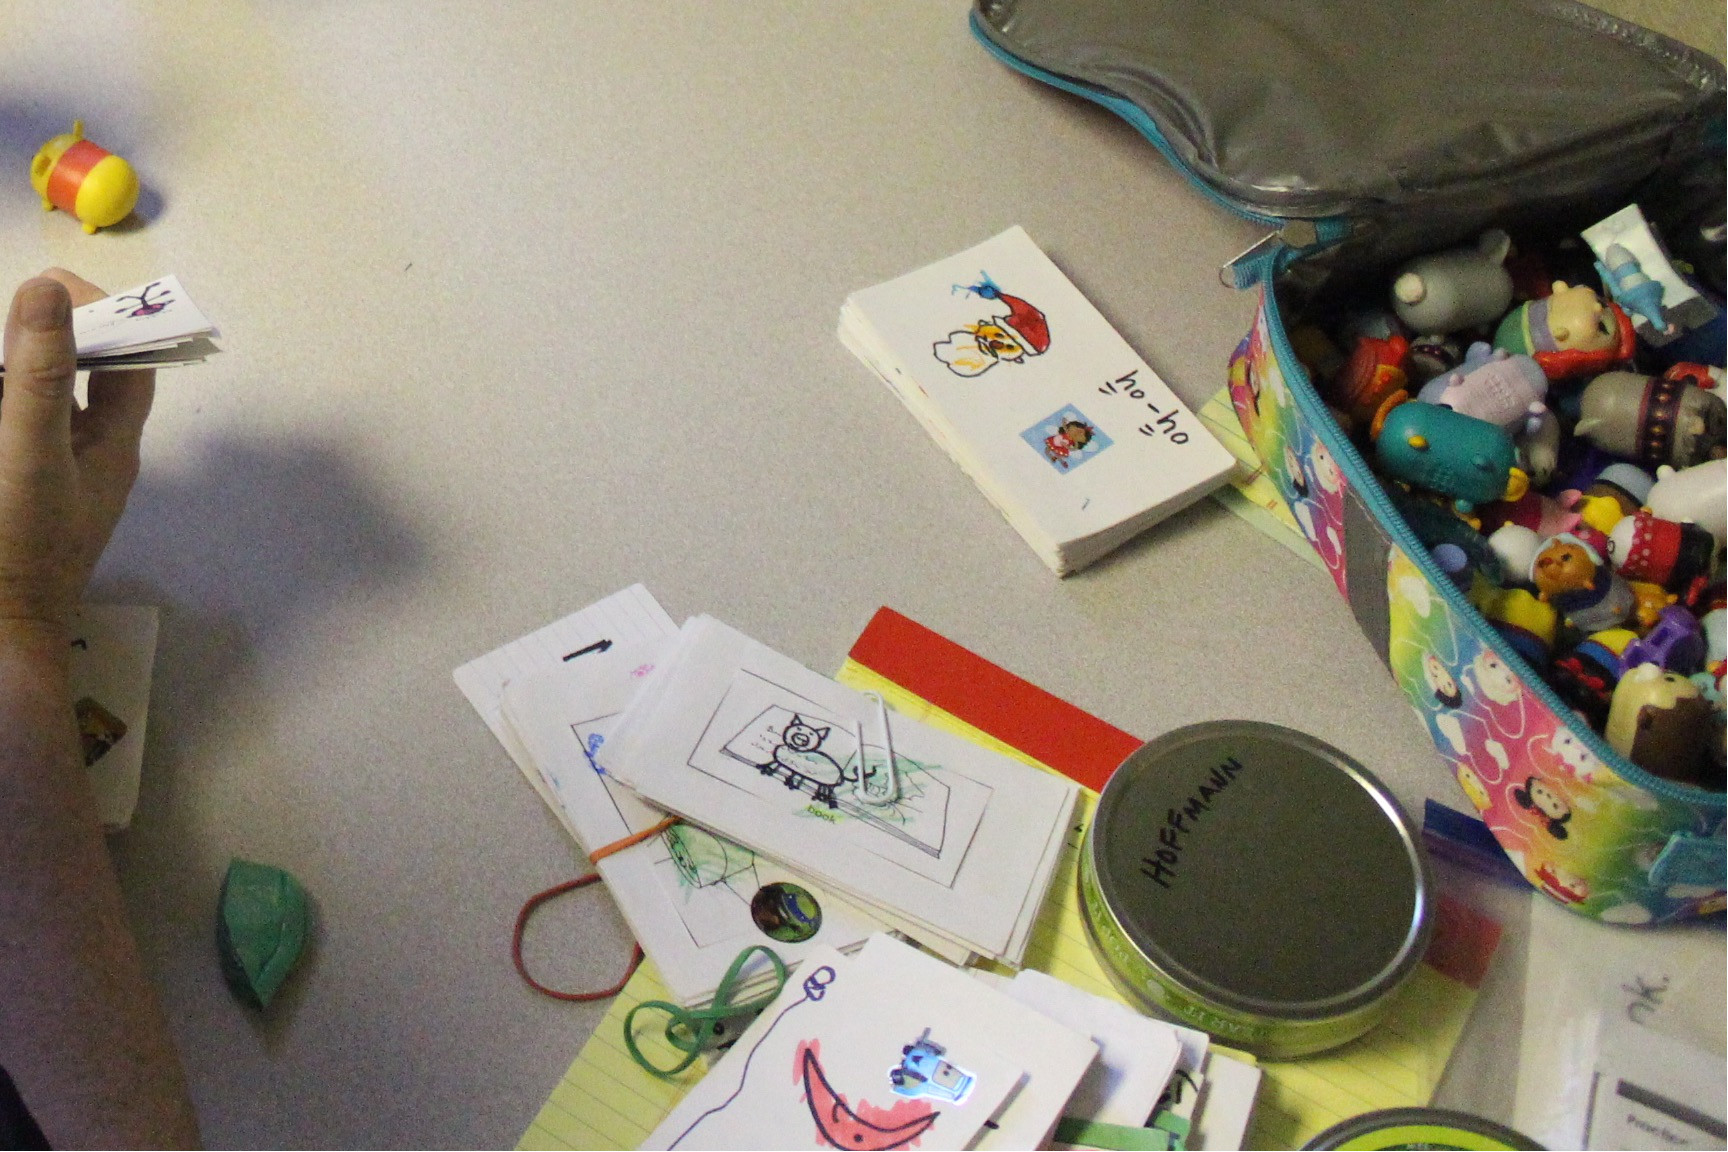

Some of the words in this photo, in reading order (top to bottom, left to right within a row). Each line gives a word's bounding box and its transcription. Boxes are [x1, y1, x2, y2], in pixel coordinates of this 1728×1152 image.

[1115, 370, 1189, 445] ho-ho
[807, 804, 837, 824] book
[1139, 756, 1243, 889] HOFFMANN
